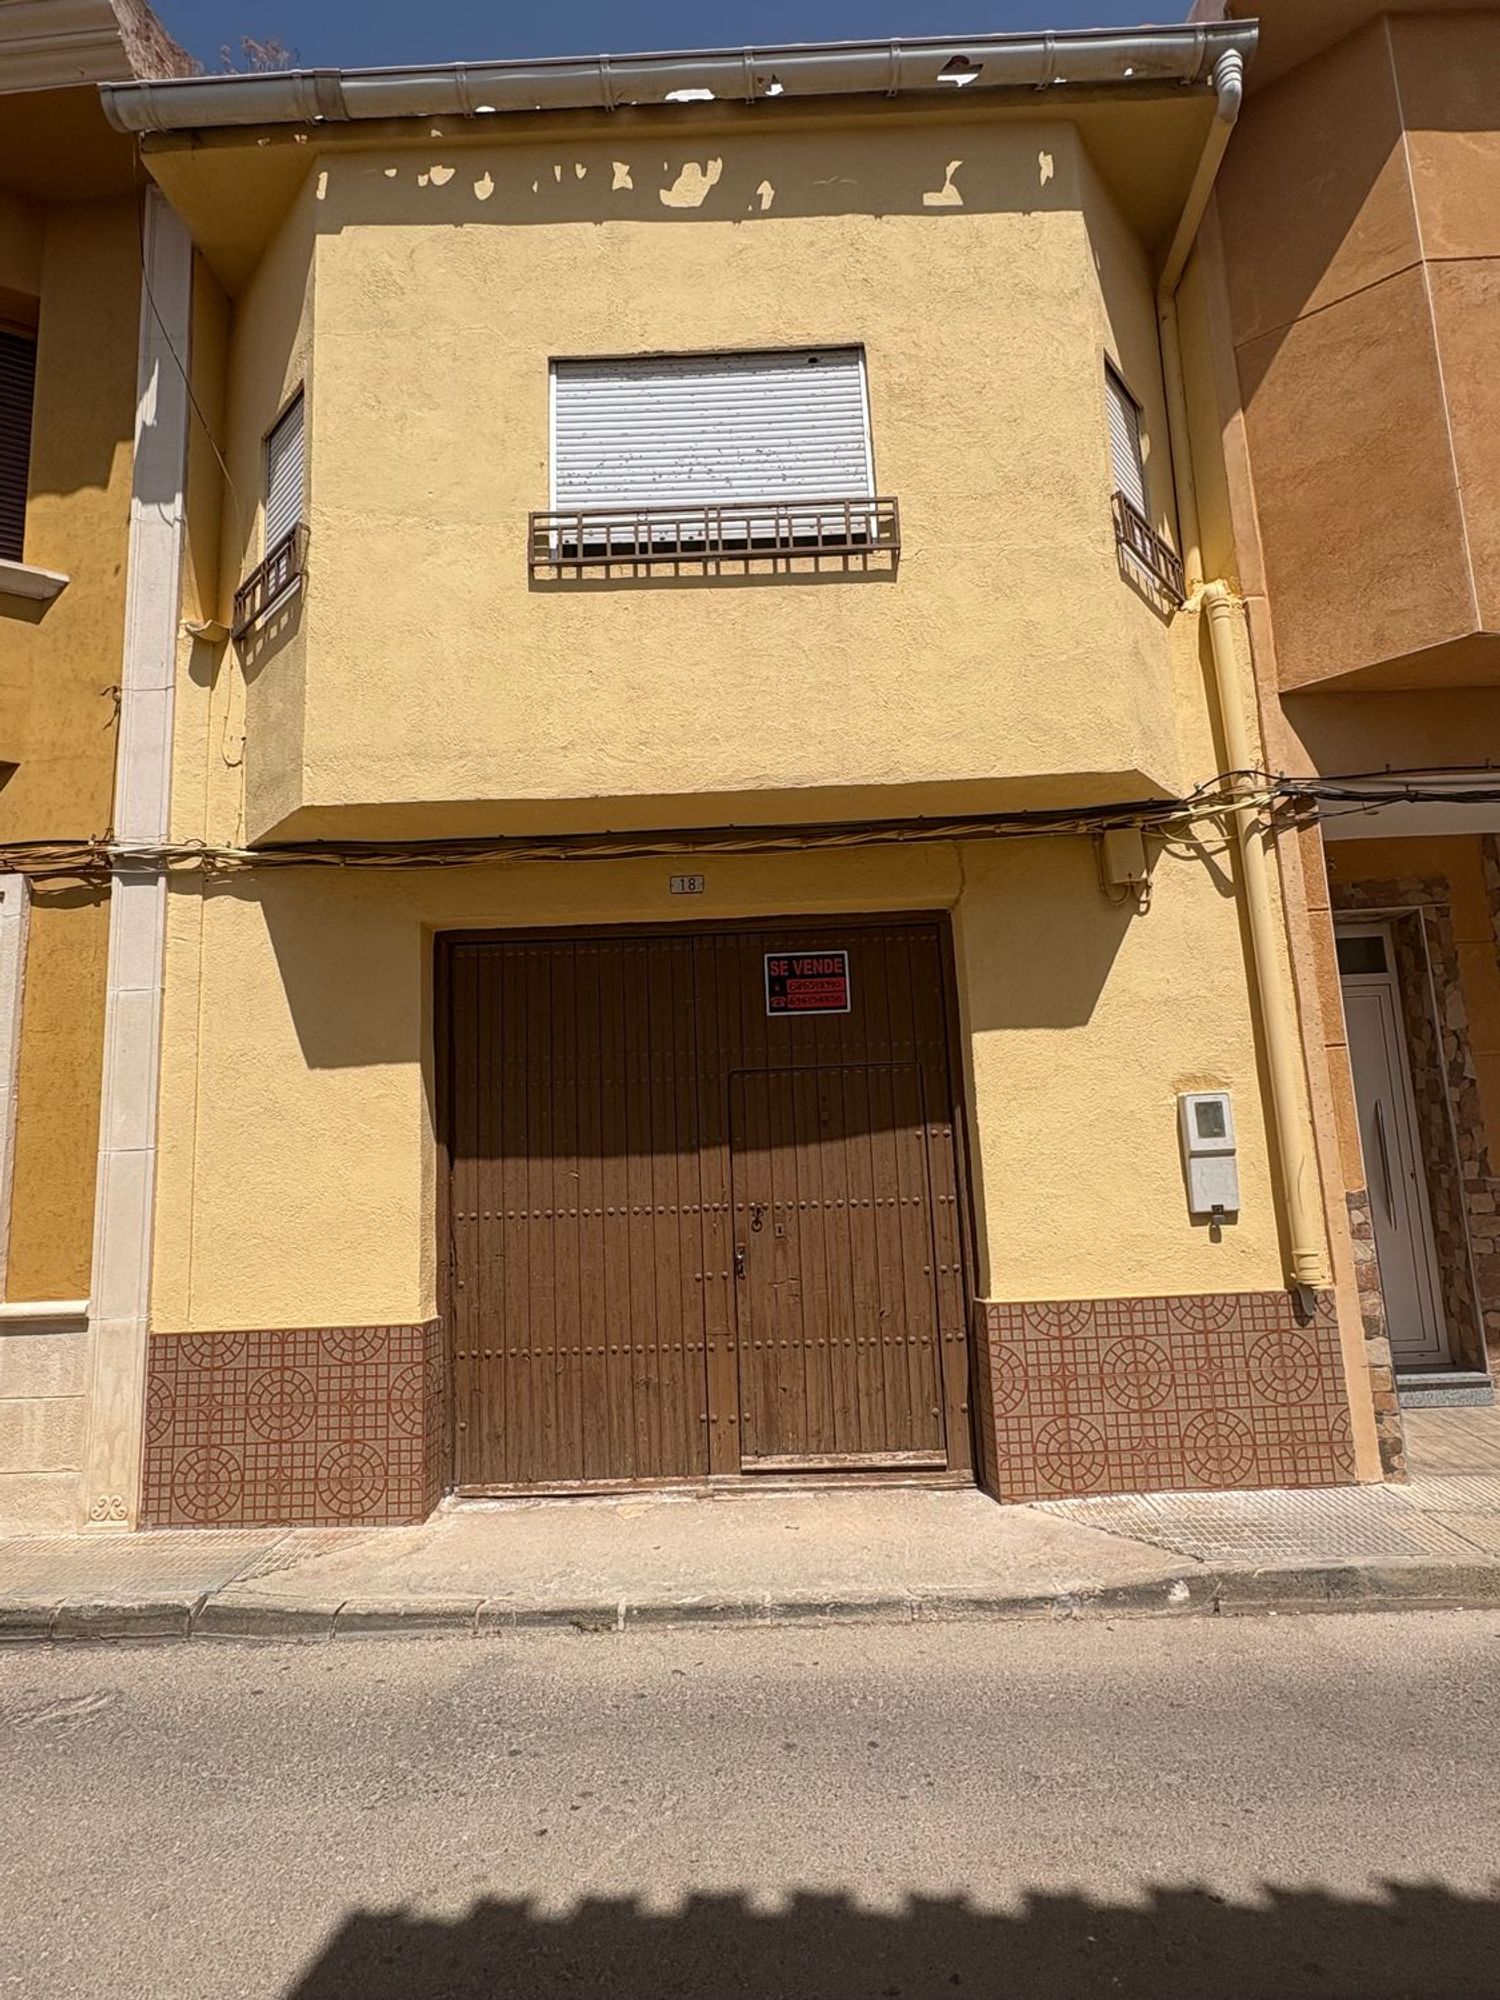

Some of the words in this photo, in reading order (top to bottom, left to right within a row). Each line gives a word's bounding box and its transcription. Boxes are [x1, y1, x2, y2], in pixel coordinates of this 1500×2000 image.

[680, 877, 696, 891] 18
[769, 960, 789, 977] SE
[792, 957, 844, 976] VENDE
